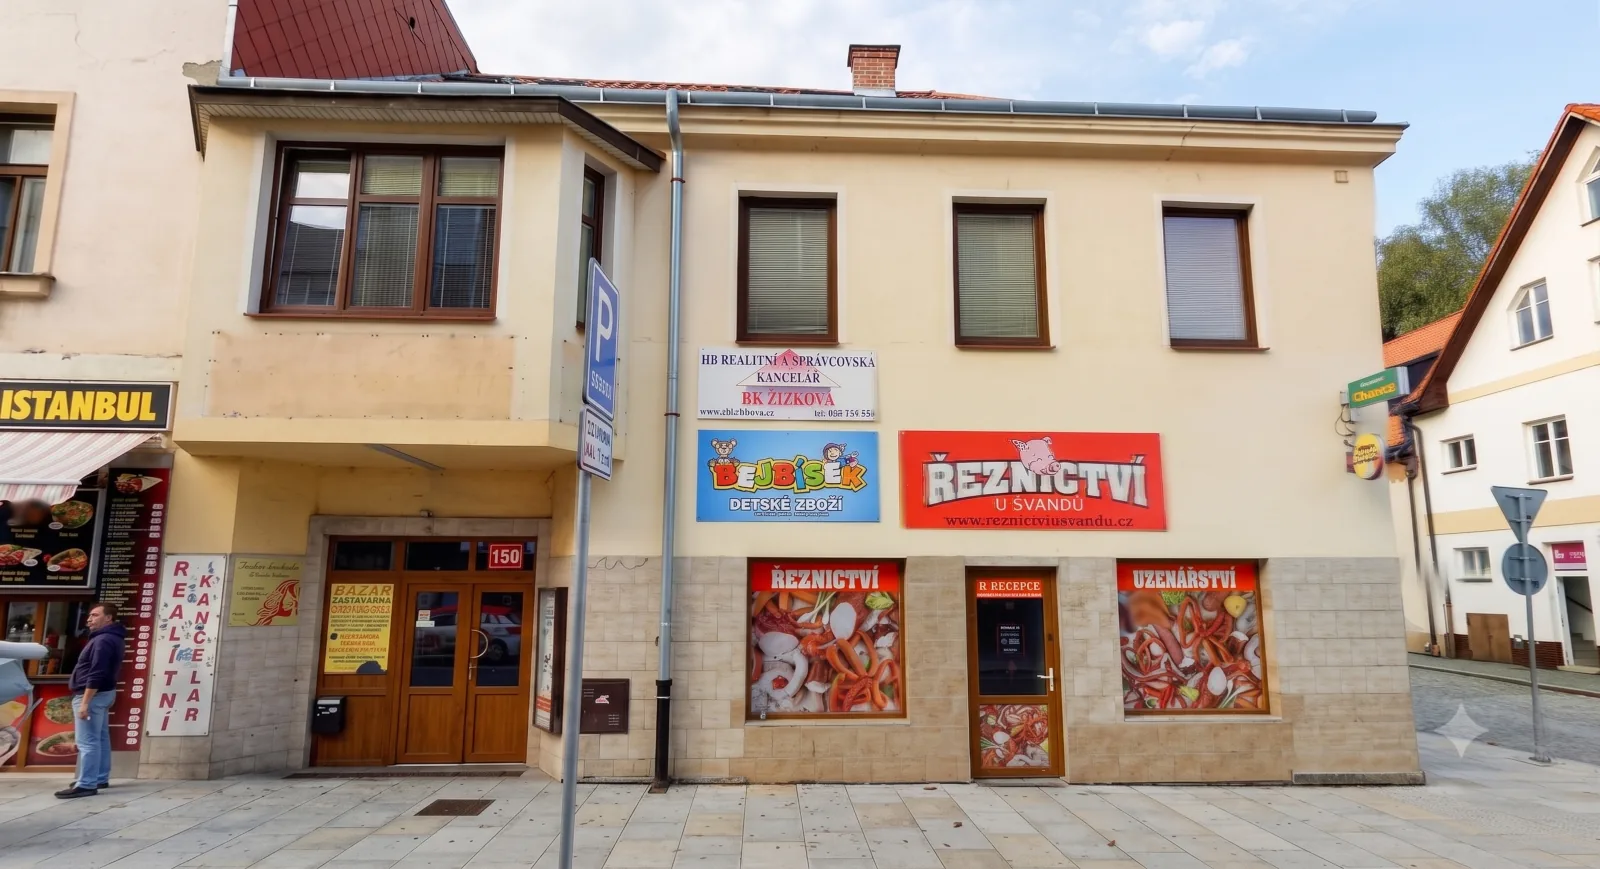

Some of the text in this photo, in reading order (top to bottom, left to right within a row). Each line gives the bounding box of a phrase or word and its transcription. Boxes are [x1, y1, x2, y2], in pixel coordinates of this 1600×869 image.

[595, 286, 613, 362] P
[701, 352, 876, 368] HB REALITNÍ A SPRÁVCOVSKÁ
[757, 369, 821, 384] KANCELÁŘ
[0, 389, 156, 422] ISTANBUL
[742, 391, 764, 405] BK
[712, 457, 864, 491] BEJBÍSEK
[795, 494, 844, 511] ZBOŽÍ
[995, 495, 1084, 511] U ŠVANDŮ
[492, 549, 520, 564] 150
[770, 564, 879, 590] ŘEZNICTVÍ
[1132, 566, 1237, 589] UZENÁŘSTVÍ
[333, 585, 392, 596] BAZAR
[979, 581, 1041, 591] R RECEPCE
